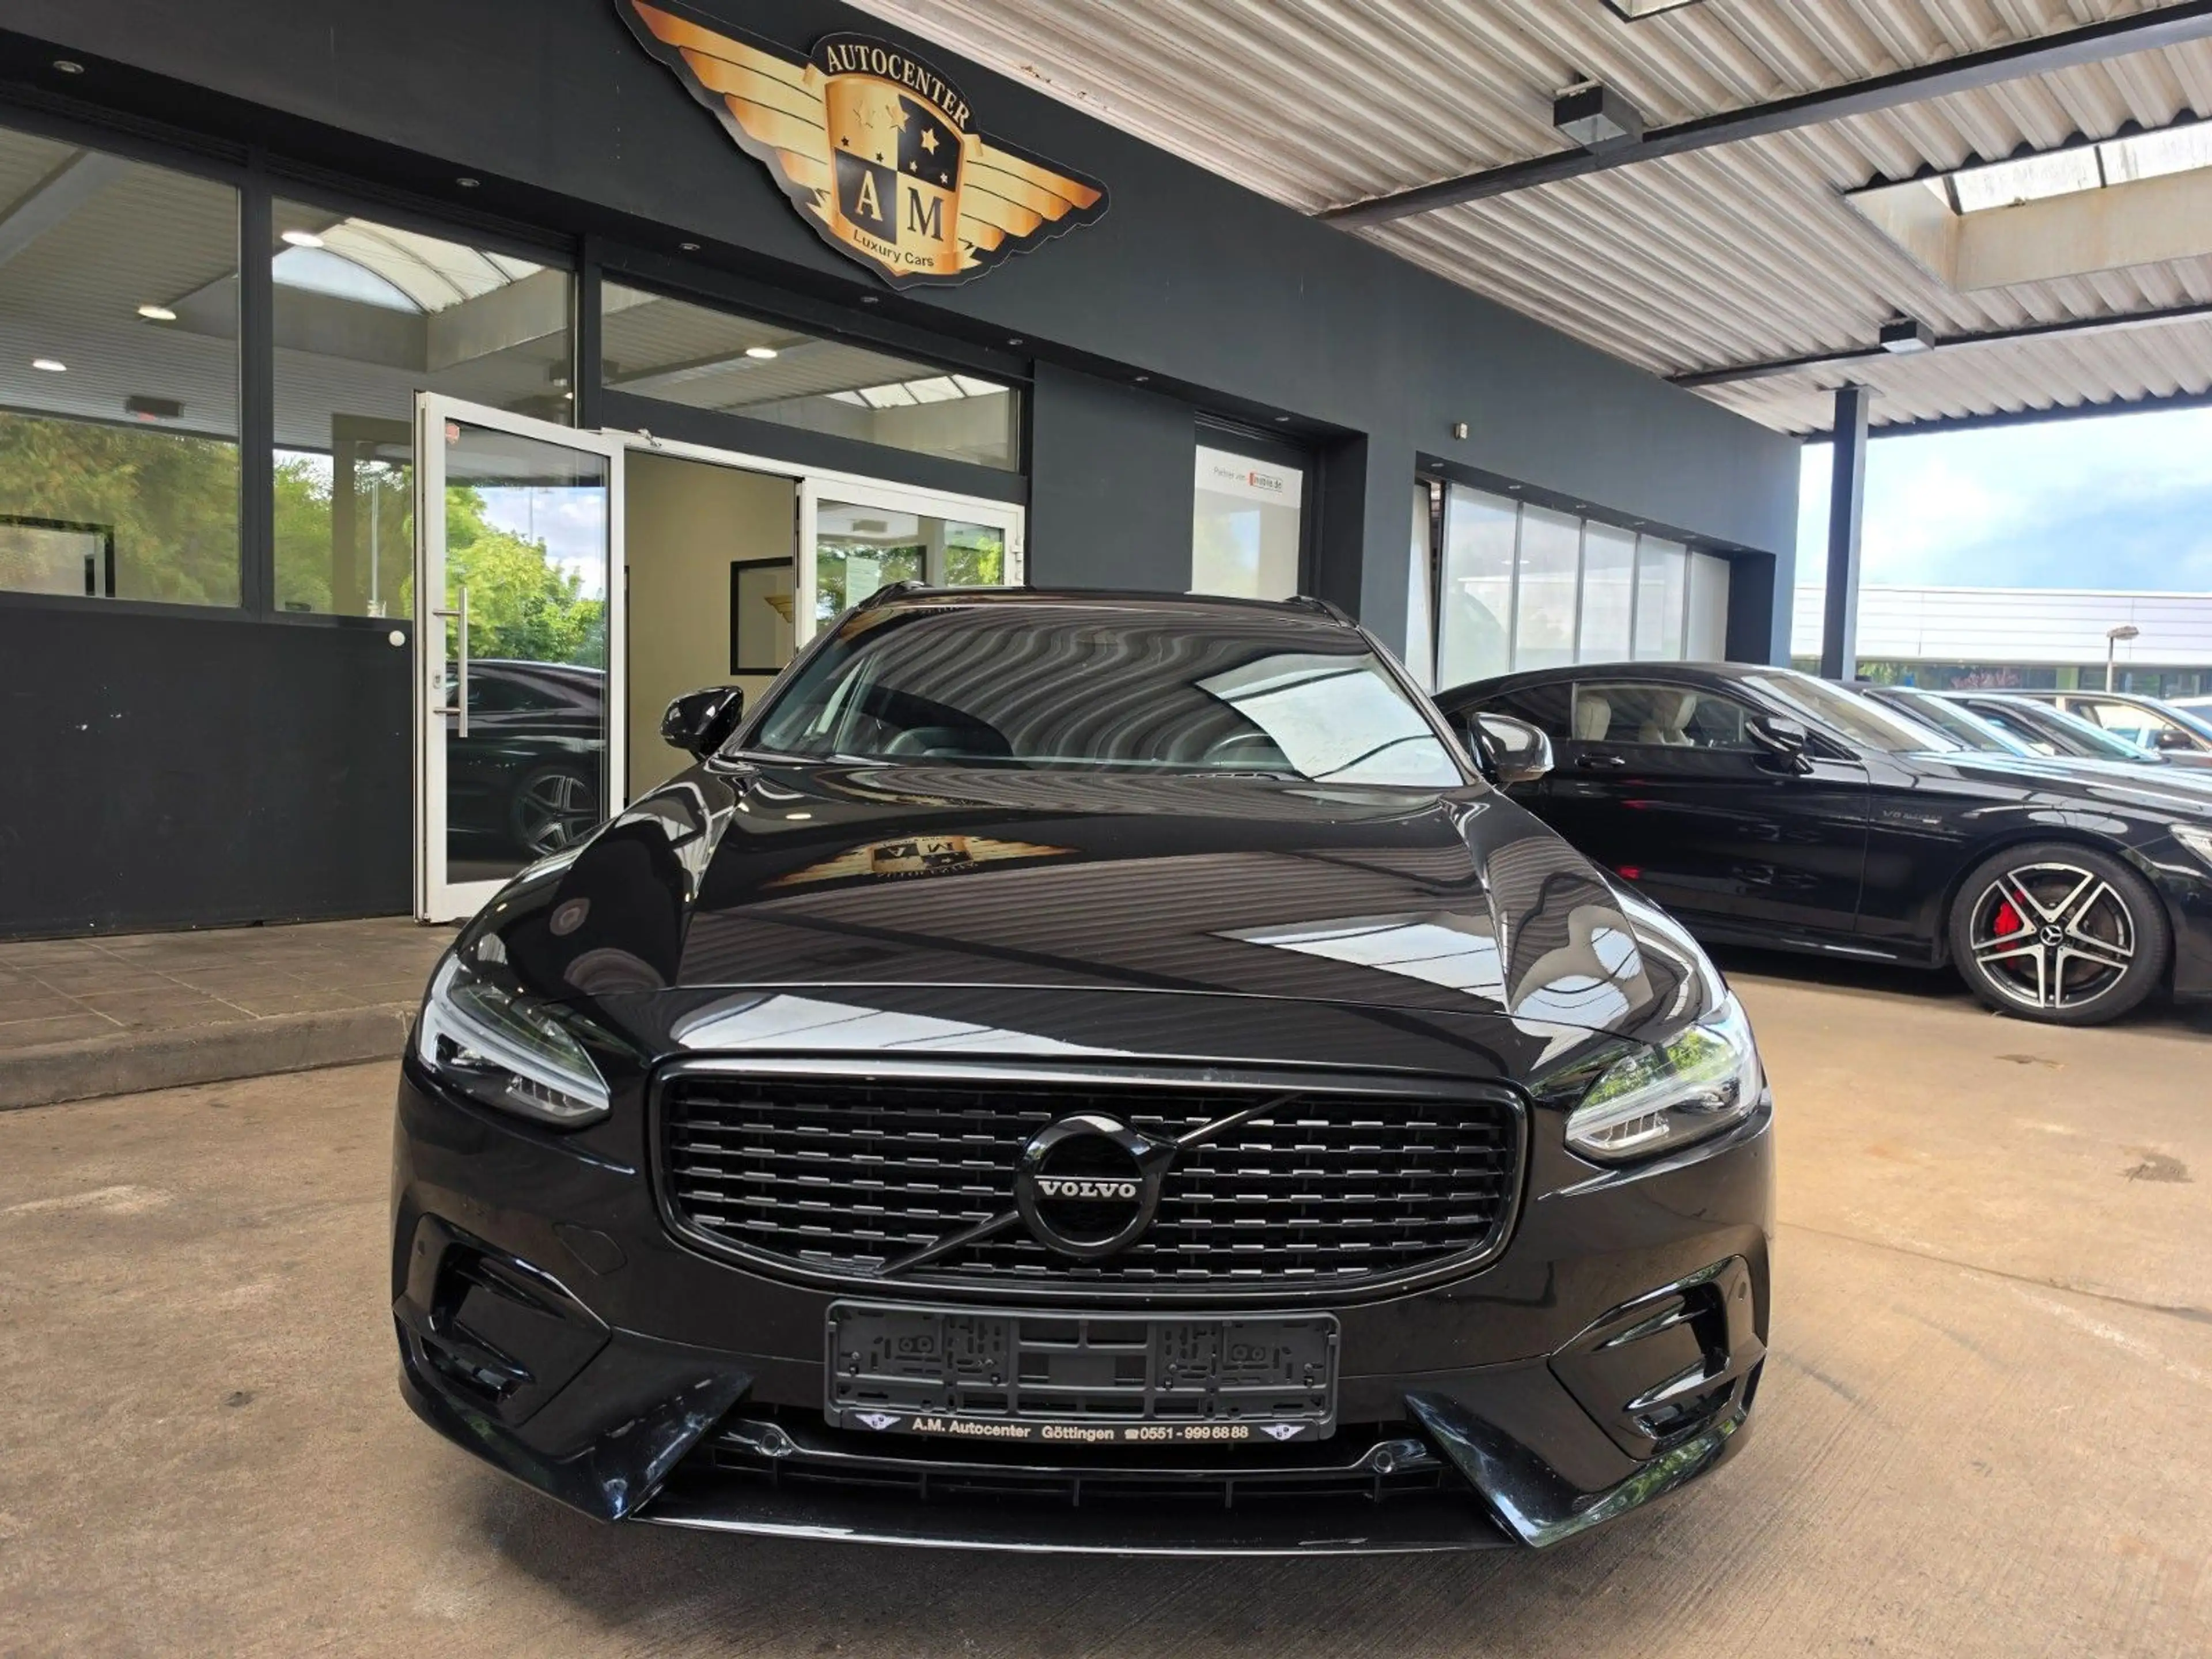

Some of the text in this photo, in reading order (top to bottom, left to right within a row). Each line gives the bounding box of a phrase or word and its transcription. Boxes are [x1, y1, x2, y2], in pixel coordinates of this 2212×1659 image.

[827, 44, 971, 130] AUTOCENTER
[855, 170, 944, 242] A M
[853, 229, 934, 267] Luxury Cars
[1038, 1180, 1137, 1198] VOLVO
[912, 1417, 945, 1431] A.M.
[949, 1420, 1031, 1437] Autocenter
[1041, 1425, 1115, 1441] Göttingen
